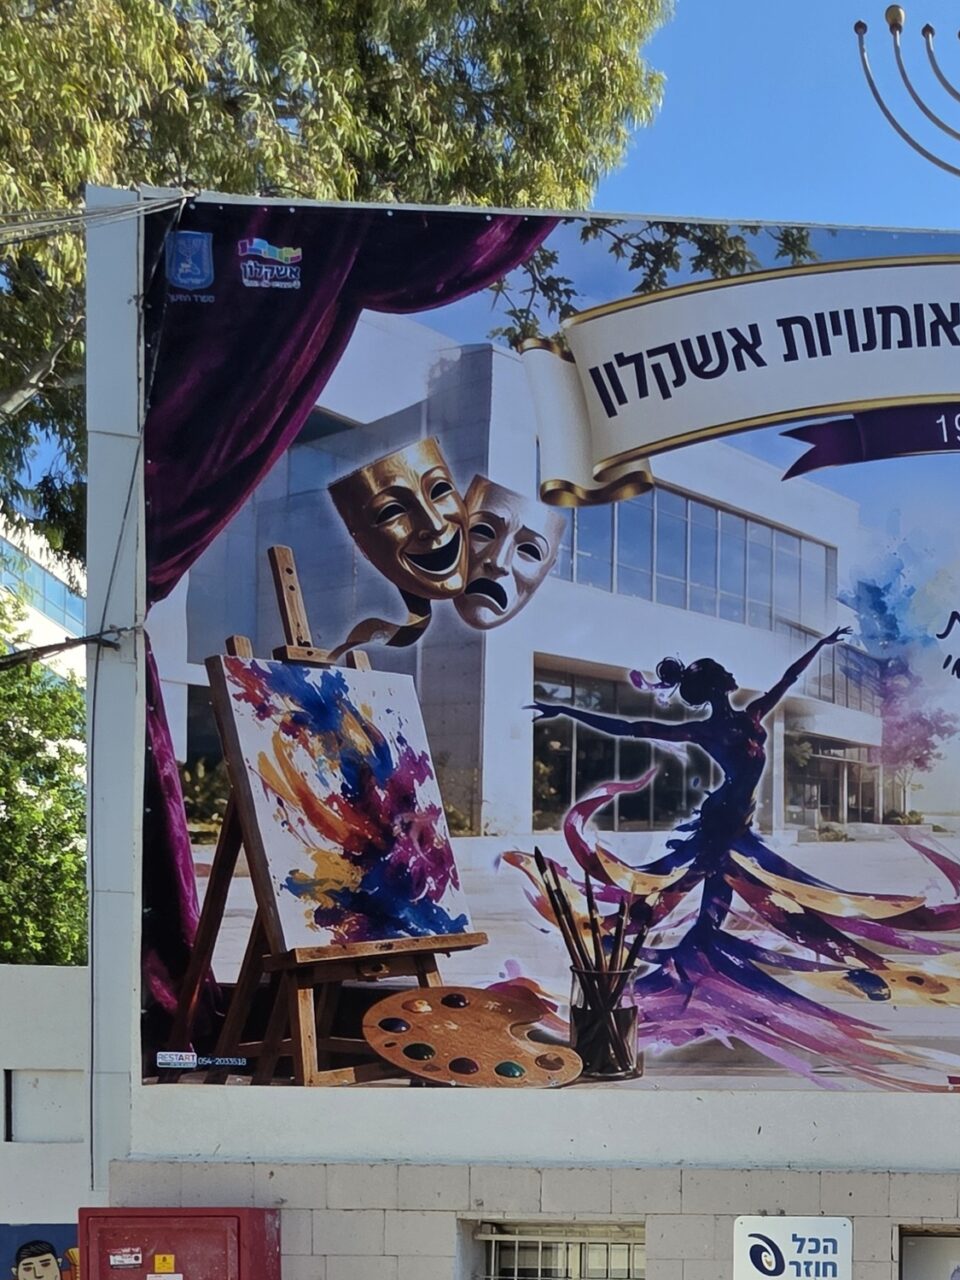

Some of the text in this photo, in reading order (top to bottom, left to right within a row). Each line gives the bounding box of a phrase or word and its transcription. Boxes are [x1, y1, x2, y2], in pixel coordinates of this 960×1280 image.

[241, 261, 300, 281] אשקלון
[588, 315, 767, 418] אשקלון
[158, 1053, 195, 1062] RESTART
[791, 1233, 838, 1255] הכל
[788, 1261, 838, 1278] חוזר
